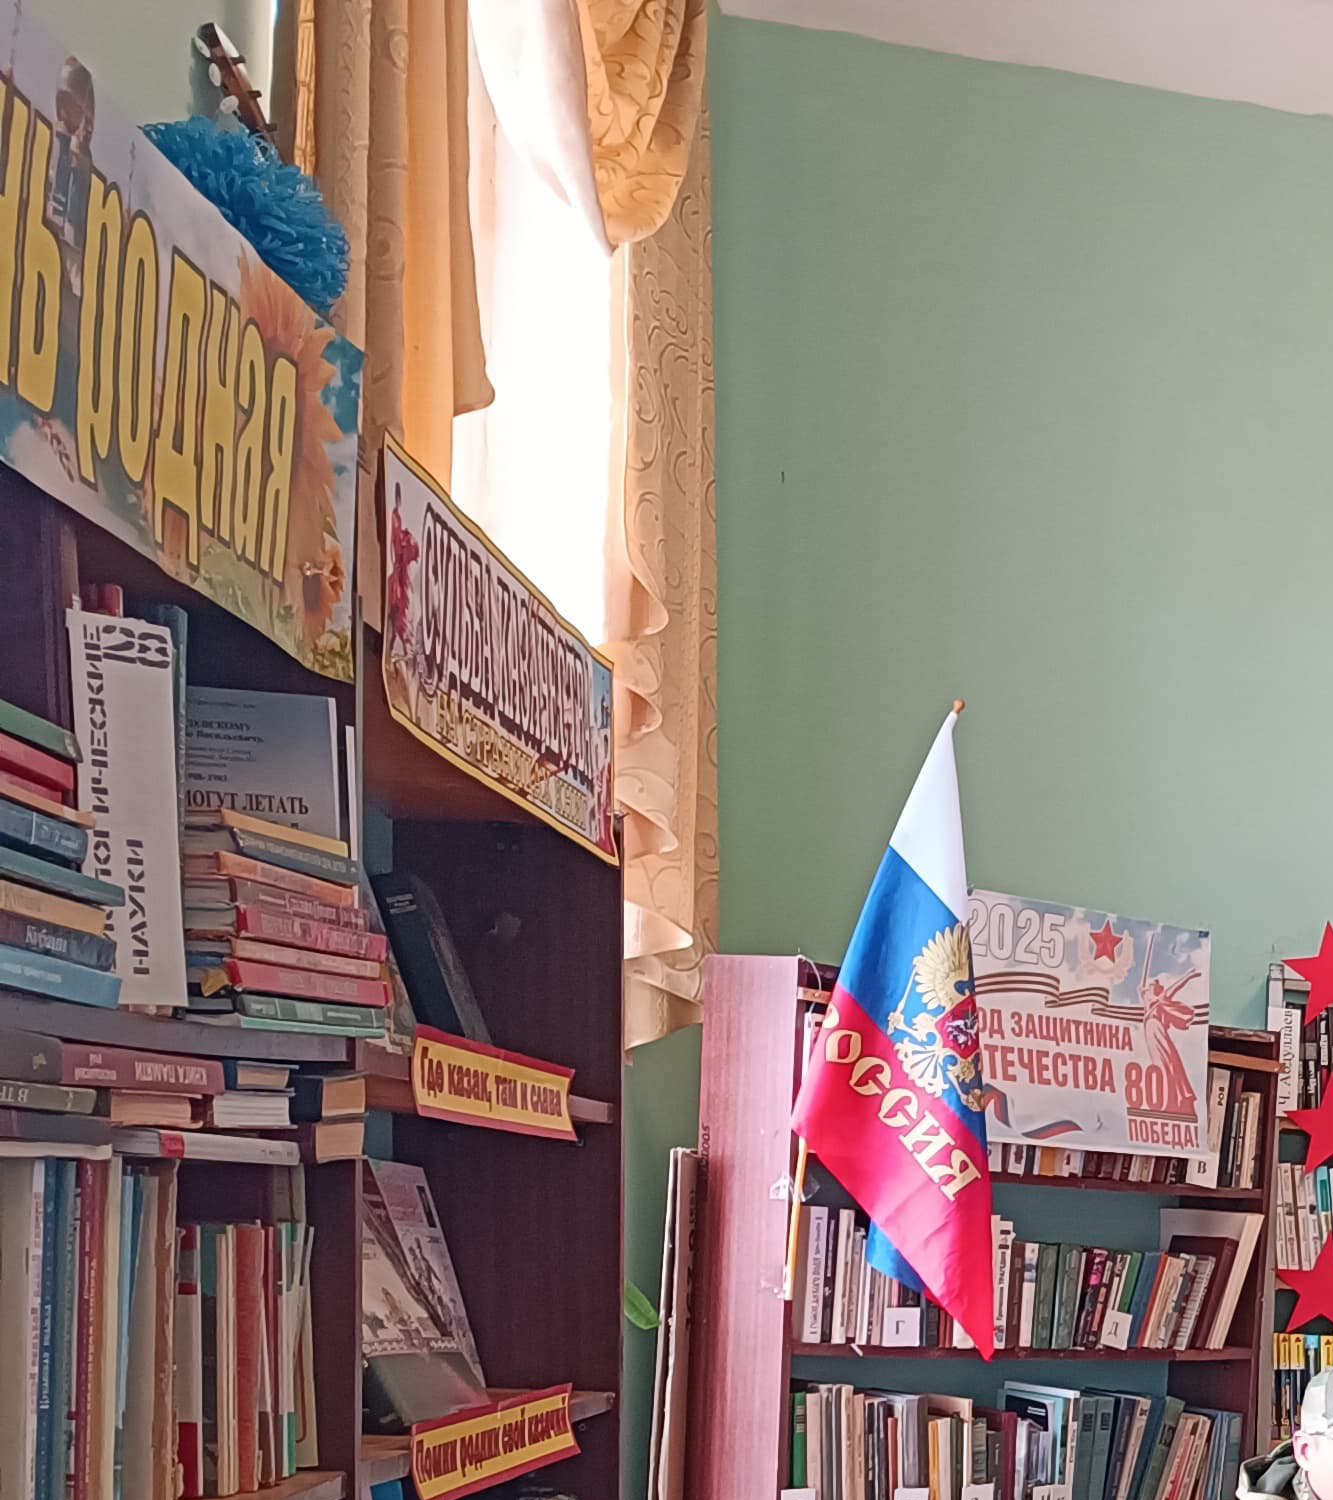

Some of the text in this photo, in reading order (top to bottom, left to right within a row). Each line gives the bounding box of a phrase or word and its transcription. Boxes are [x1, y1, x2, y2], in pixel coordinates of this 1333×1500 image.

[242, 793, 310, 815] ЛЕТАТЬ
[125, 838, 150, 976] НАУКИ
[967, 896, 1066, 969] 2025
[977, 1007, 1134, 1052] ОД ЗАЩИТНИКА
[420, 1046, 563, 1118] Где казак, там и слава
[978, 1043, 1117, 1094] ТЕЧЕСТВА
[1124, 1061, 1164, 1112] 80
[1127, 1116, 1201, 1150] ПОБЕДА!
[1107, 1320, 1119, 1337] Д
